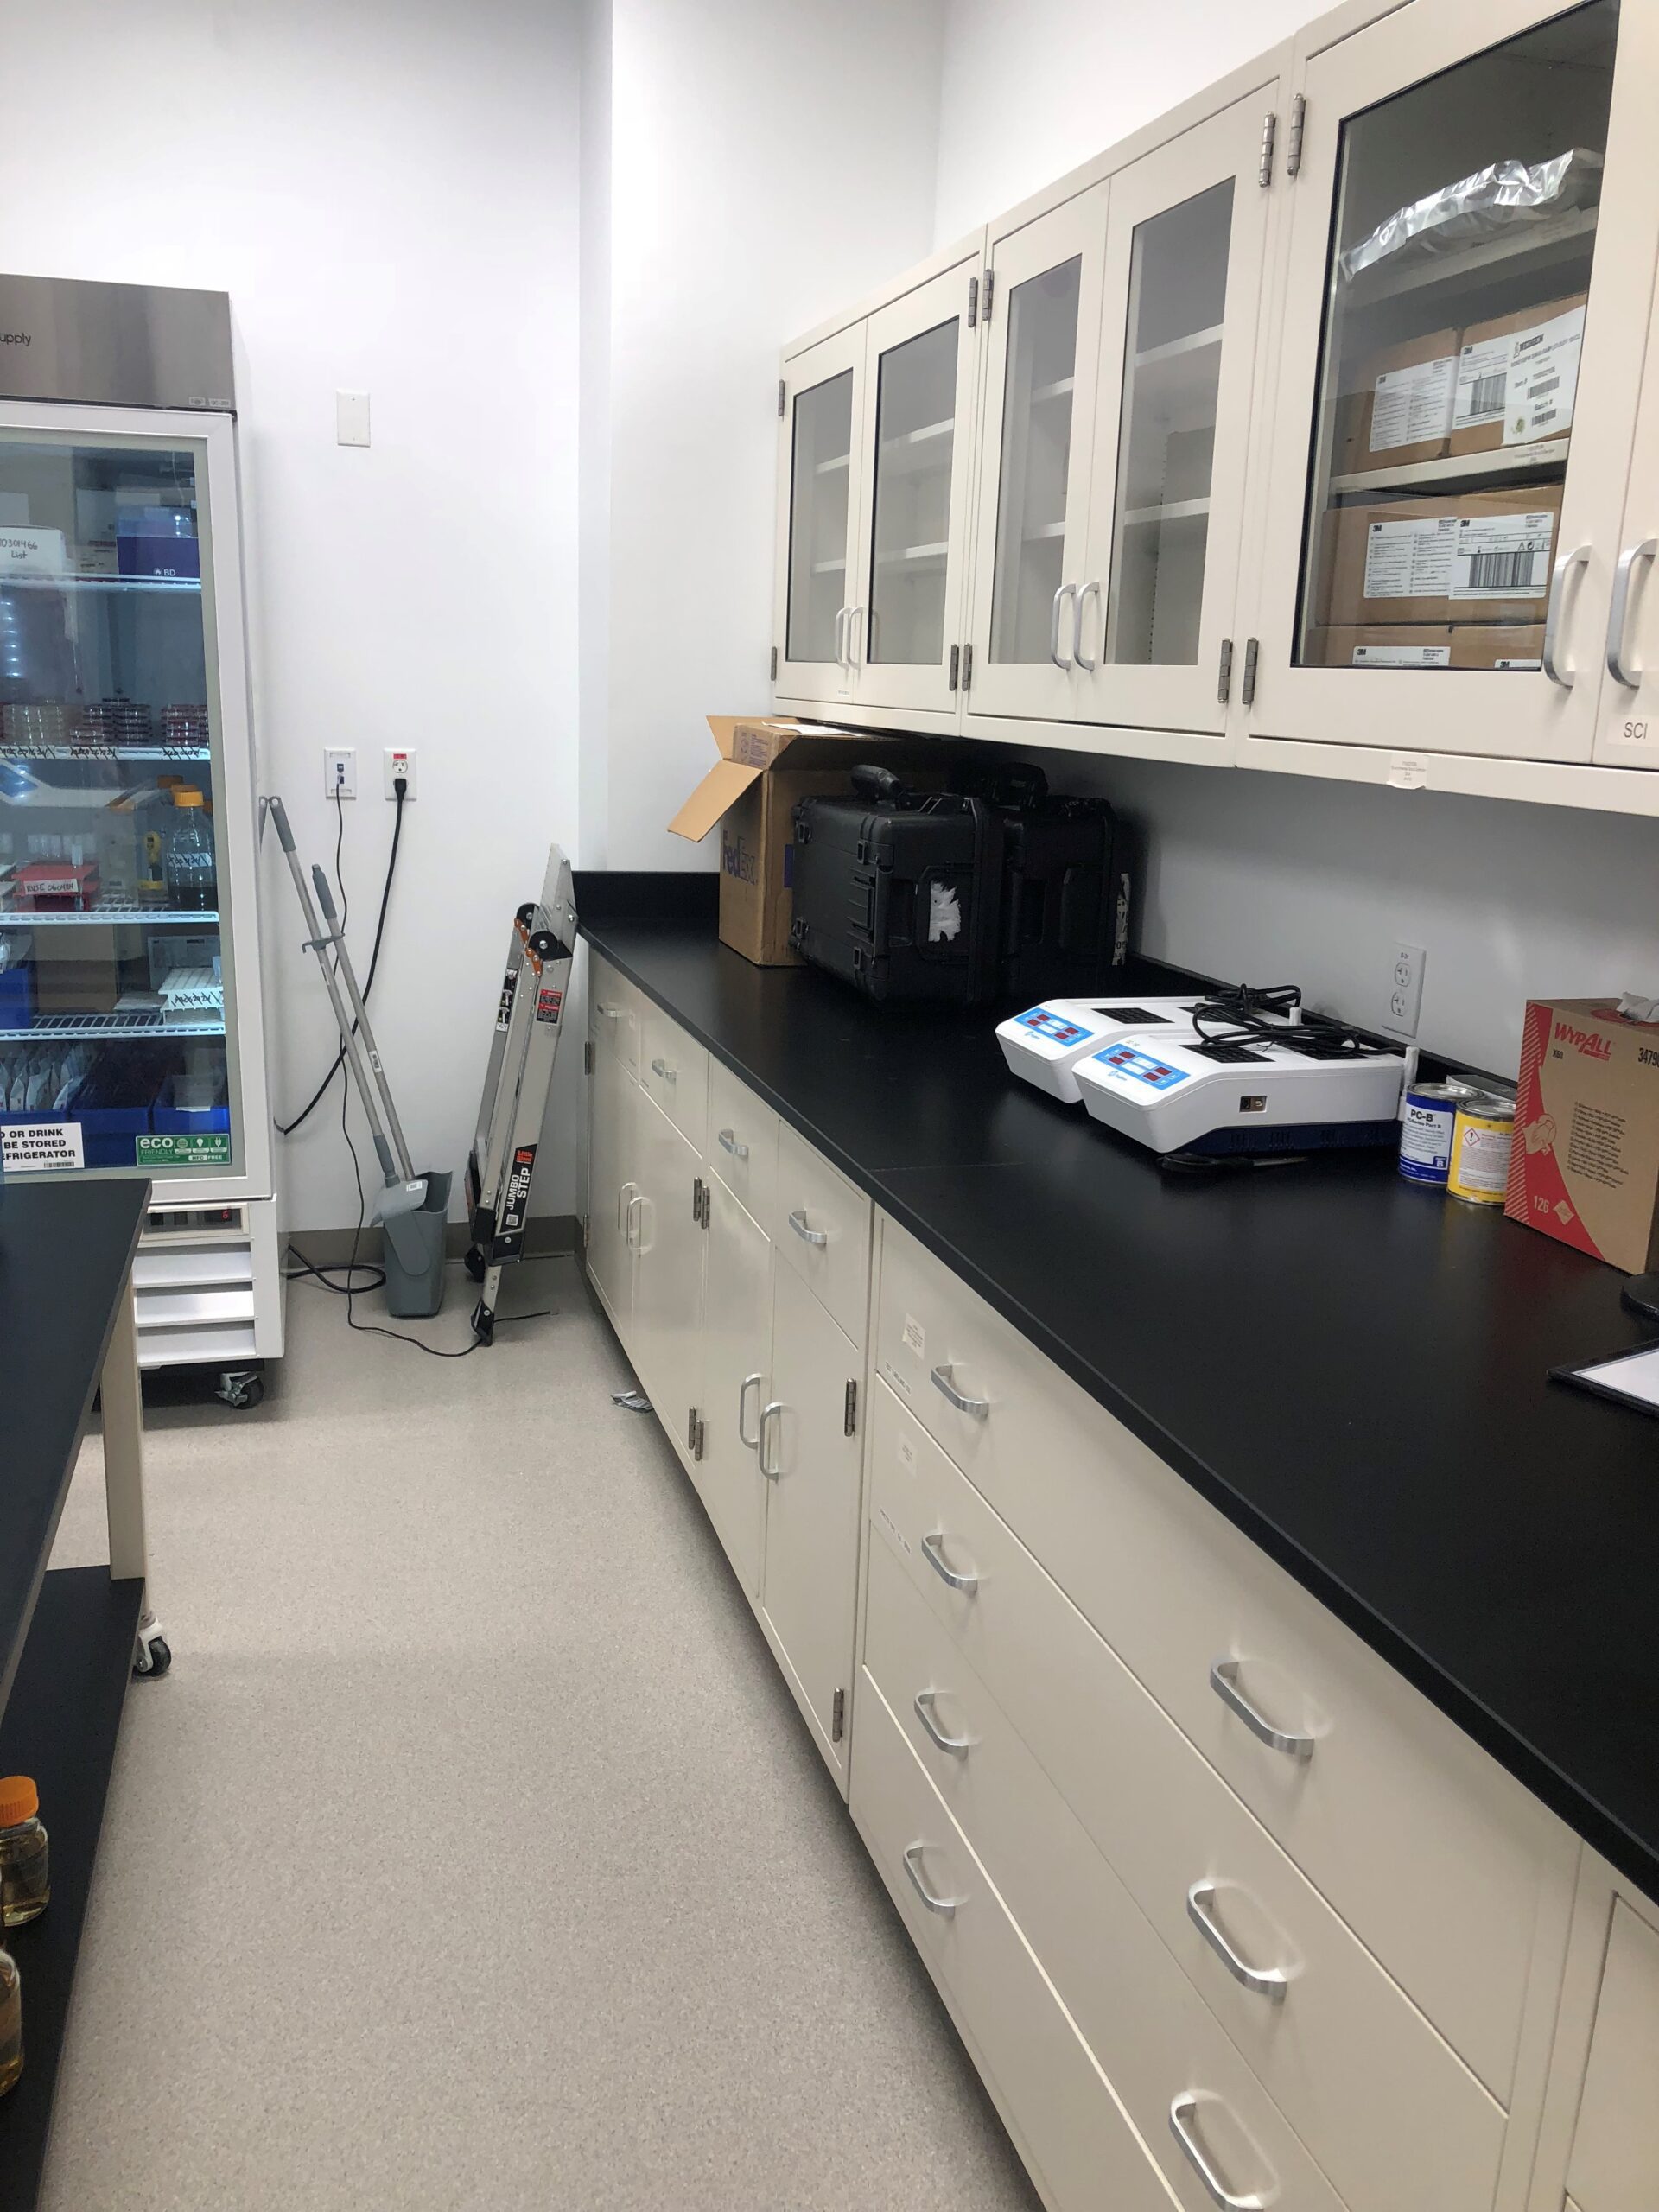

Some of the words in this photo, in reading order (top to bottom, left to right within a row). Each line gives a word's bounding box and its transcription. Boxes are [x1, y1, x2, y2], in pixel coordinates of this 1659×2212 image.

[1624, 722, 1648, 739] SCI
[1410, 1109, 1433, 1122] PC-B
[9, 1130, 25, 1139] OR
[29, 1128, 64, 1138] DRINK
[22, 1140, 66, 1148] STORED
[140, 1138, 173, 1148] eco
[517, 1167, 531, 1198] STEP
[506, 1174, 520, 1210] JUMBO
[1534, 1195, 1549, 1214] 126
[222, 1210, 229, 1219] 6
